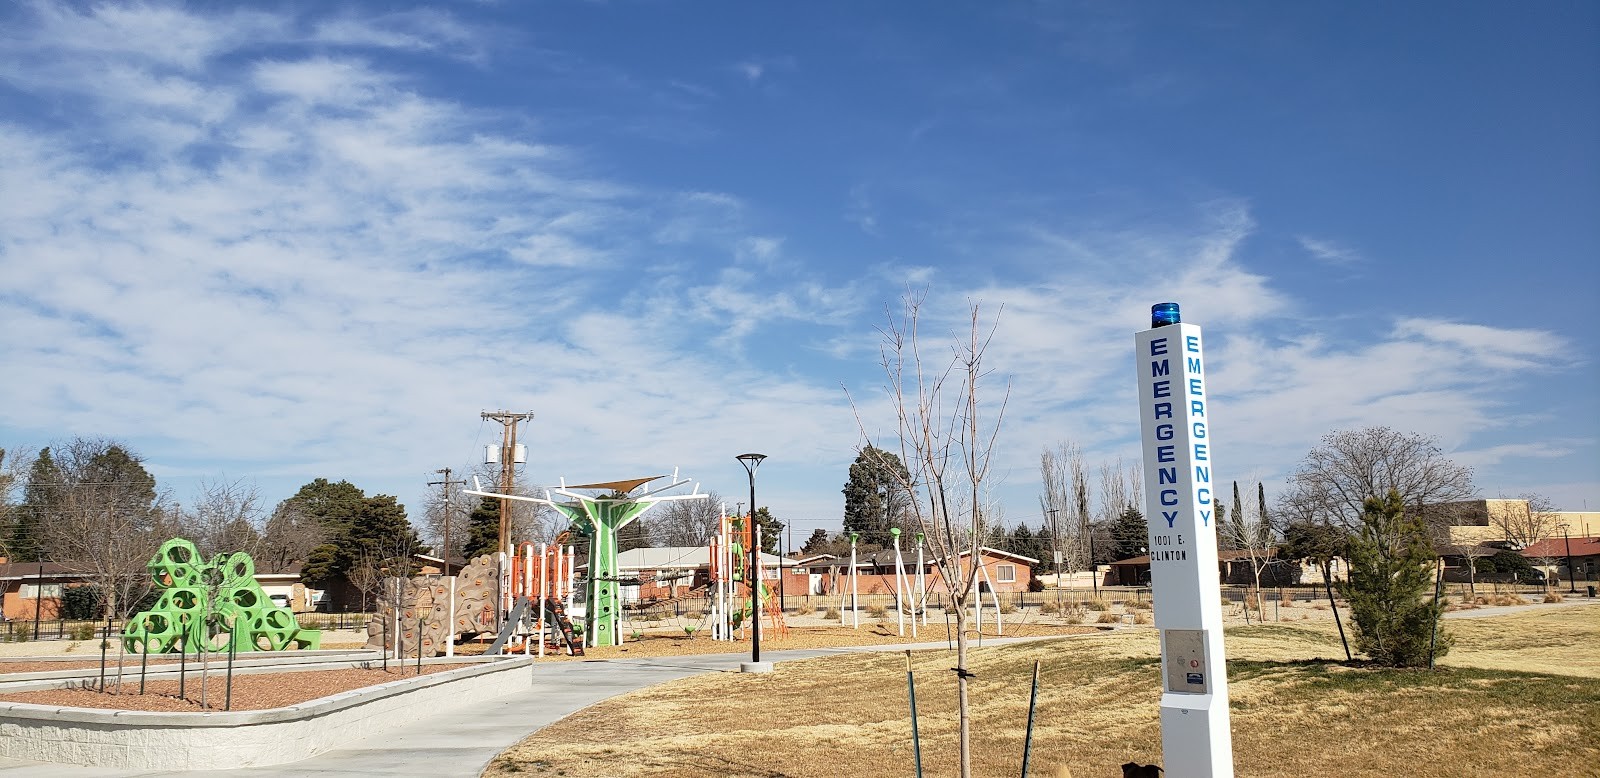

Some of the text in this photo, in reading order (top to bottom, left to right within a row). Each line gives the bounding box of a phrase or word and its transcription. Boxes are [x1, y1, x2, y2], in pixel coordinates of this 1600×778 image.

[1151, 337, 1179, 528] EMERGENCY
[1186, 335, 1211, 527] EMERGENCY
[1150, 550, 1187, 561] CLINTON
[1154, 534, 1185, 546] 1001 E.
